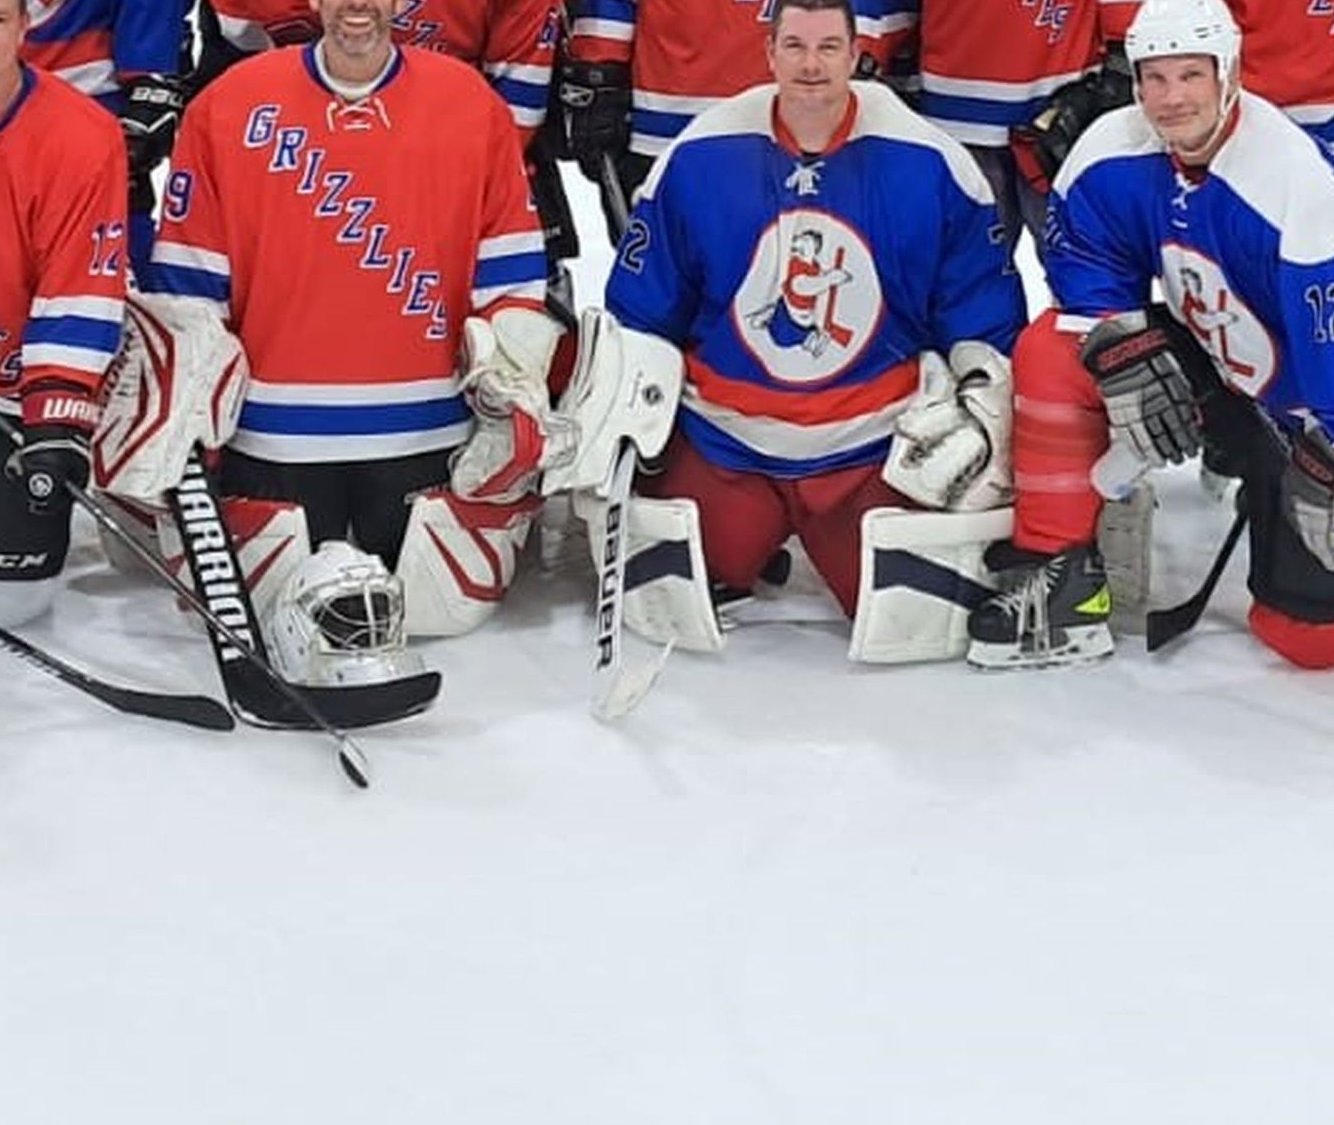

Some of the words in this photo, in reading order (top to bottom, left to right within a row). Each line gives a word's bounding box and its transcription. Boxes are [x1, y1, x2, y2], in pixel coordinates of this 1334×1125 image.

[165, 171, 195, 220] 9
[243, 104, 449, 340] GRIZZLIES
[88, 222, 125, 277] 12
[619, 219, 651, 274] 2
[596, 502, 623, 672] BAUER
